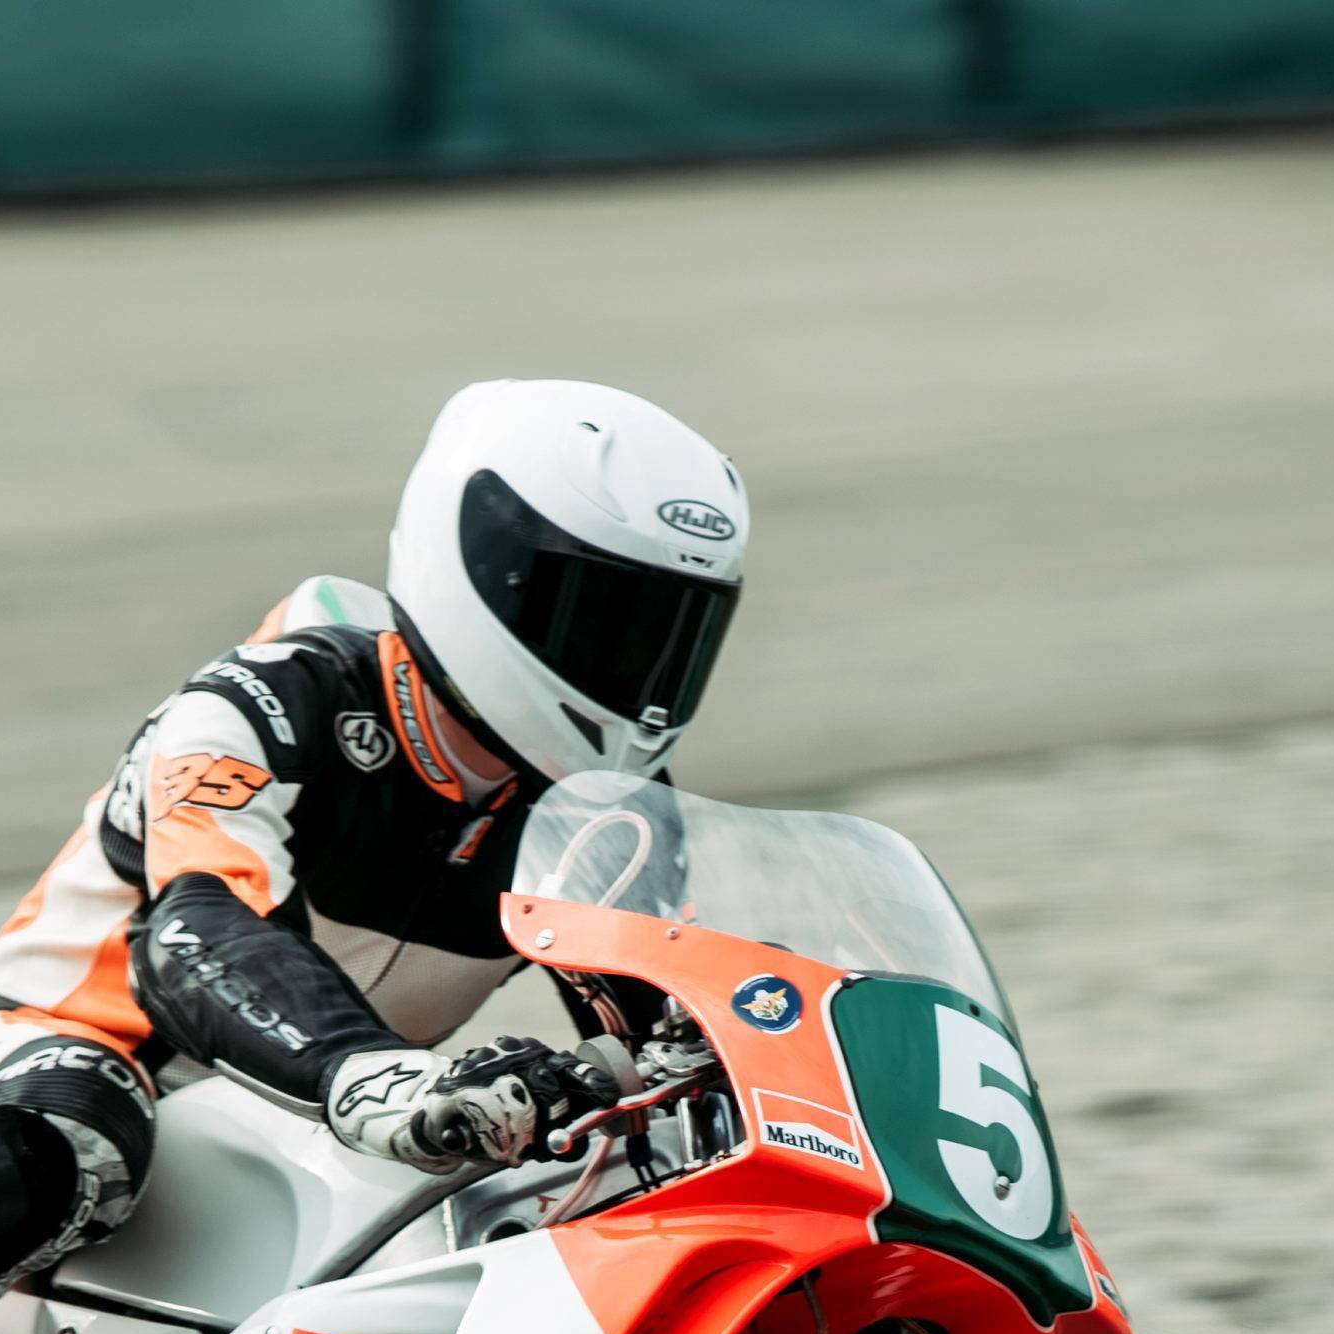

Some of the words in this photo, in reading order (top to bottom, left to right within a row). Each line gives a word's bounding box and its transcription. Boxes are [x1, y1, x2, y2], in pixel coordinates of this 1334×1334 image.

[669, 505, 729, 535] HJC
[933, 1002, 1054, 1241] 5
[765, 1123, 860, 1166] Marlboro
